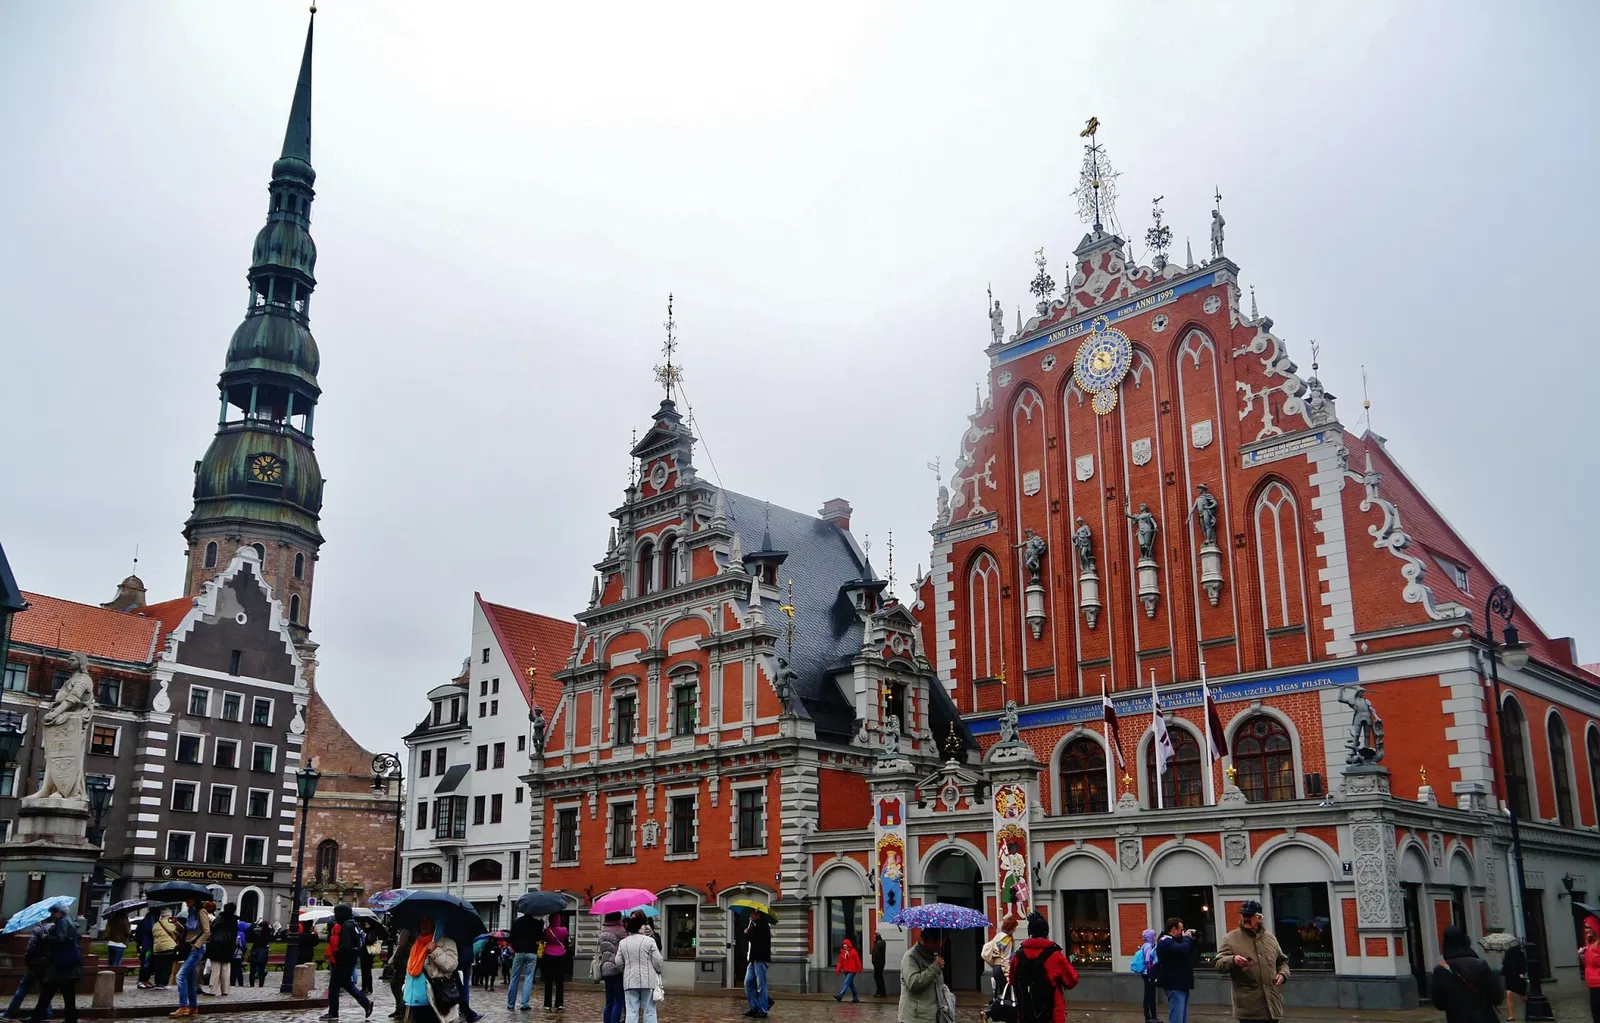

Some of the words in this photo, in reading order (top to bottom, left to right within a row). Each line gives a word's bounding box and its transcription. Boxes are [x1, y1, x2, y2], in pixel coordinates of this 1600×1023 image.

[1135, 295, 1156, 310] ANNO
[1157, 288, 1174, 302] 1999
[1047, 328, 1066, 344] ANNO
[1130, 698, 1147, 706] TIKA
[1149, 692, 1182, 704] SGRAUTS
[1168, 696, 1203, 708] PAMATIEM
[1219, 690, 1242, 701] JAUNA
[176, 868, 204, 879] Golden
[206, 869, 233, 880] Coffee
